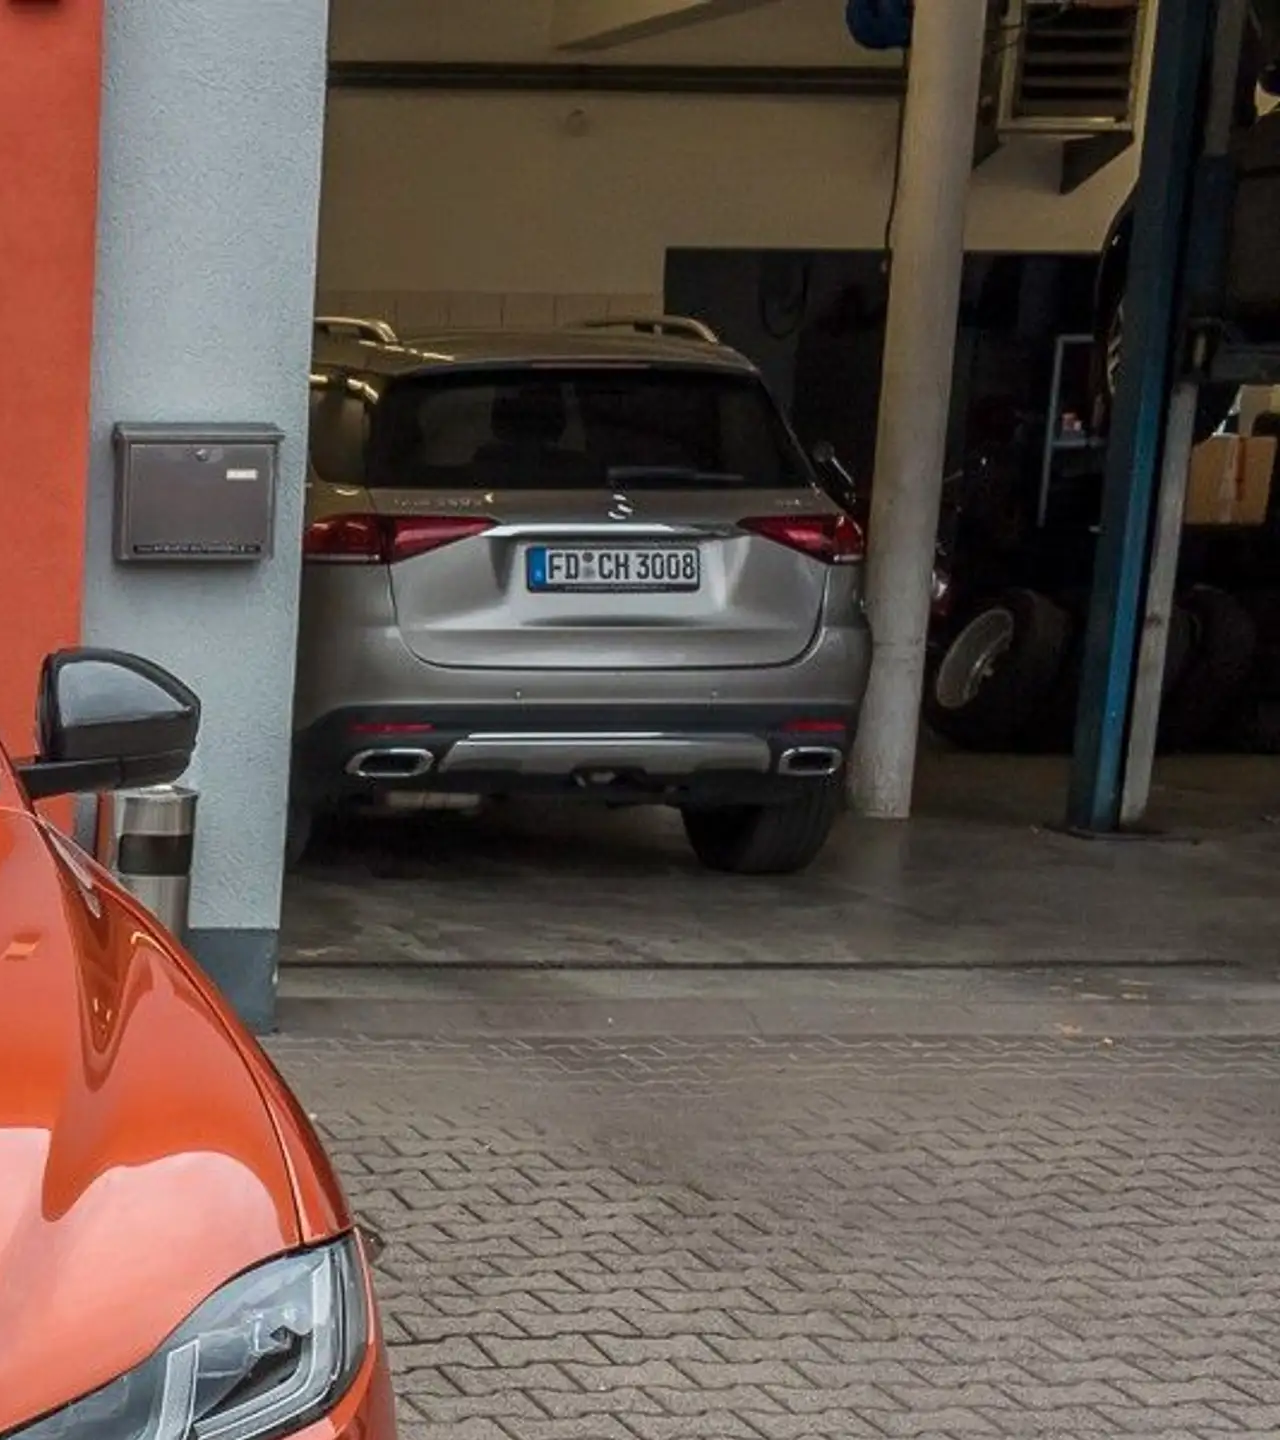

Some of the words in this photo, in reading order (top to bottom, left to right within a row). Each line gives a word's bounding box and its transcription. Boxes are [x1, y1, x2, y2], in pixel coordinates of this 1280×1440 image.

[548, 552, 579, 580] FD
[598, 552, 629, 580] CH
[635, 552, 696, 580] 3008
